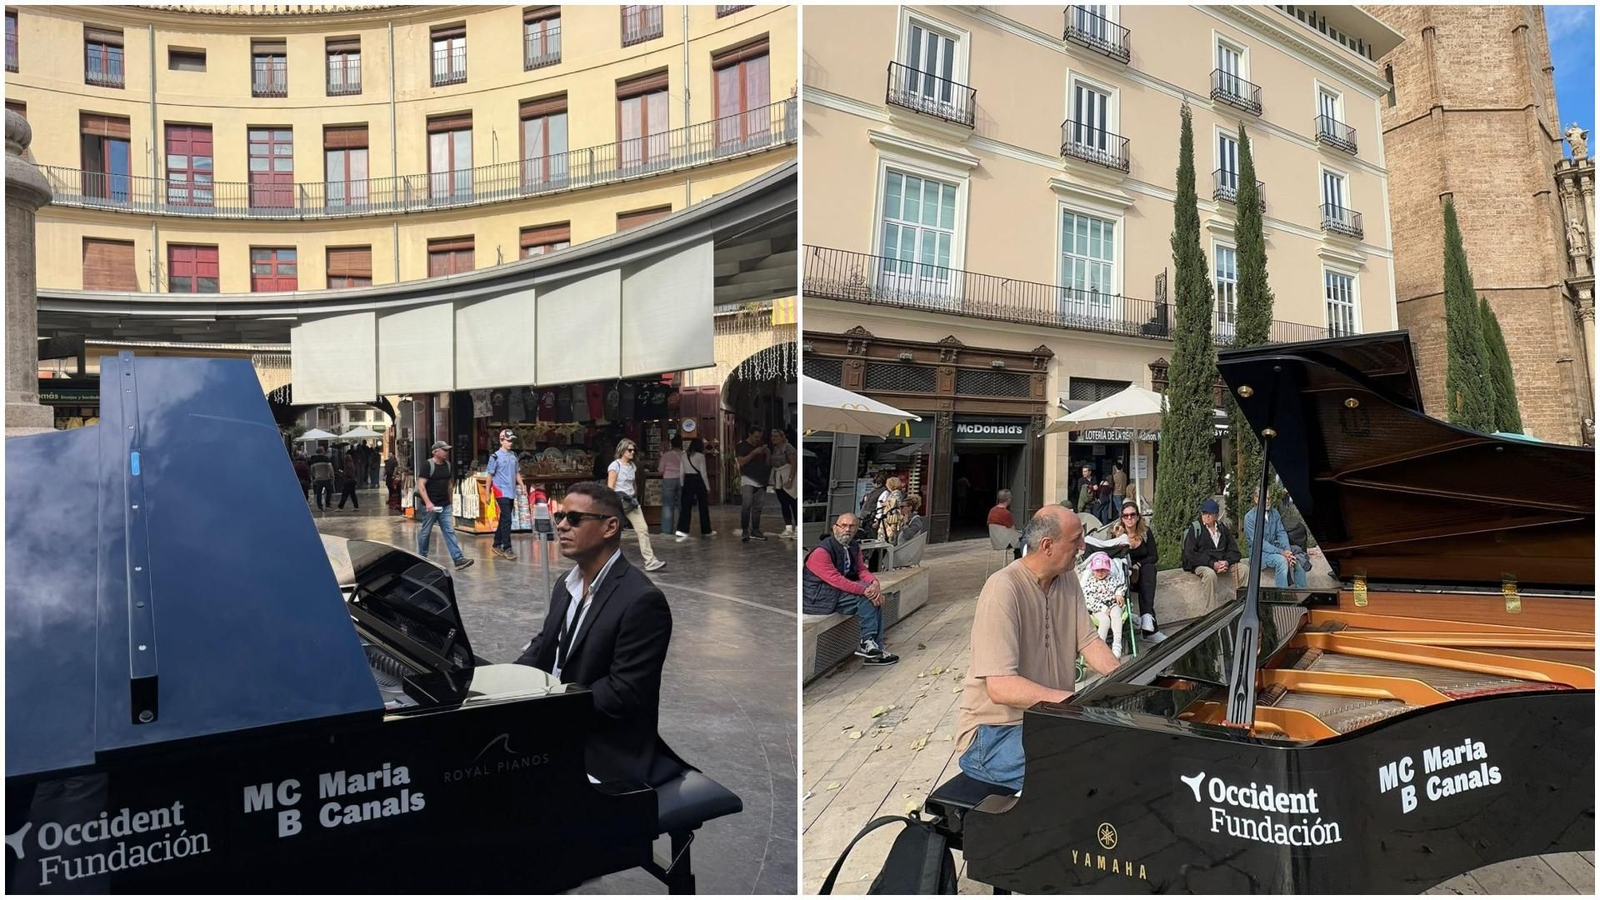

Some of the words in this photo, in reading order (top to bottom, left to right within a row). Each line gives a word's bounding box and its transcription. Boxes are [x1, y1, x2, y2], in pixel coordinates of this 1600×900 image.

[956, 423, 1023, 434] McDonald's
[1085, 429, 1107, 440] LOTERÍA
[1107, 430, 1115, 440] DE
[1115, 430, 1122, 441] LA
[444, 764, 491, 783] ROYAL
[497, 753, 549, 773] PIANOS
[1378, 756, 1415, 794] MC
[1422, 738, 1488, 775] Maria
[243, 778, 302, 813] MC
[318, 762, 411, 799] Maria
[1208, 777, 1320, 814] Occident
[1426, 762, 1502, 801] Canals
[318, 789, 426, 828] Canals
[1401, 785, 1418, 814] B
[37, 800, 185, 851] Occident
[277, 809, 302, 838] B
[1209, 806, 1342, 847] Fundación
[38, 829, 211, 886] Fundación
[1072, 849, 1147, 880] YAMAHA
